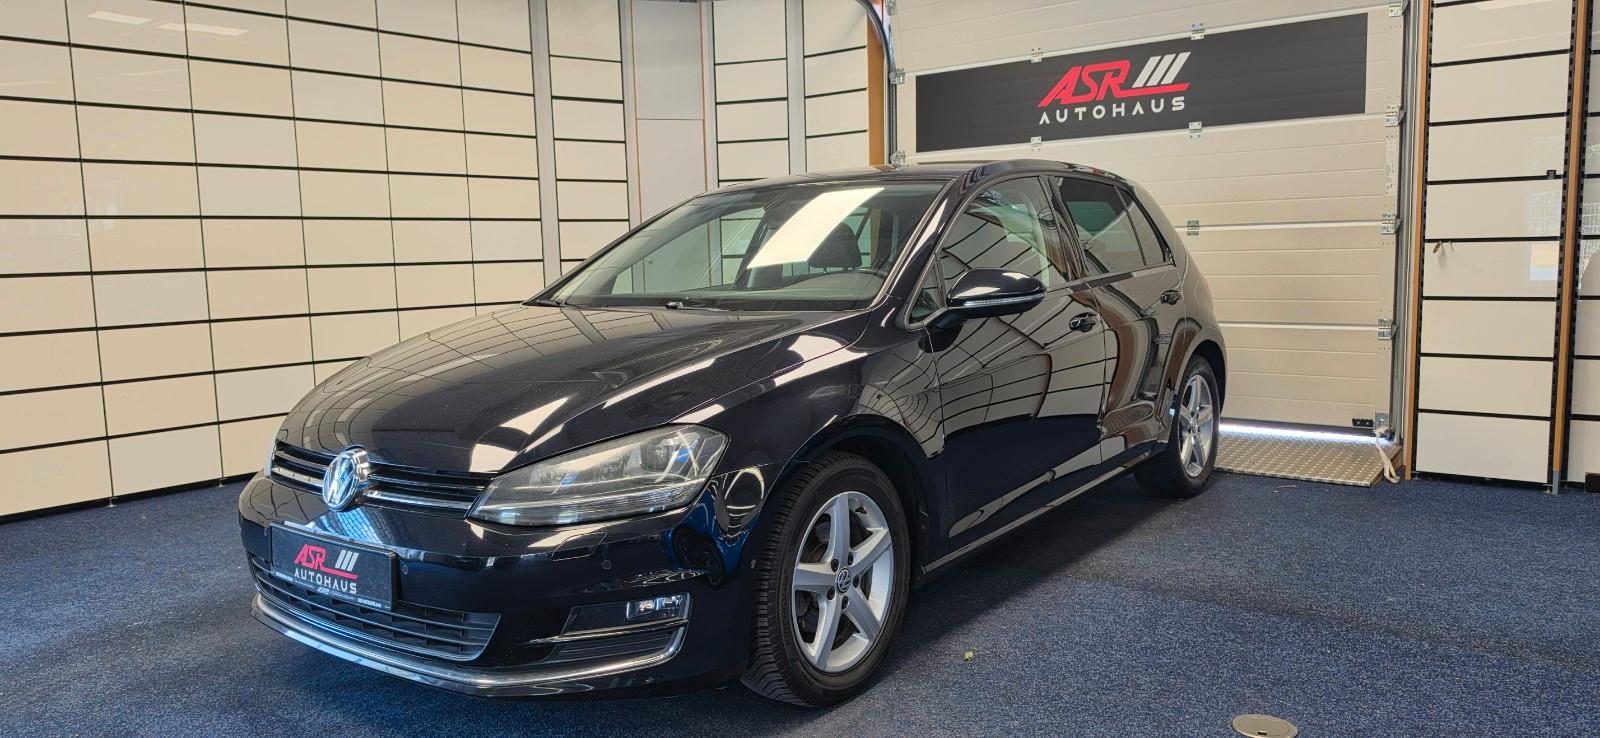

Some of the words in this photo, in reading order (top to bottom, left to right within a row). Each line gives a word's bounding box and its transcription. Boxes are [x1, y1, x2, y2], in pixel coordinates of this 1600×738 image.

[1037, 59, 1190, 108] ASR
[1039, 96, 1185, 125] AUTOHAUS
[294, 567, 357, 594] AUTOHAUS
